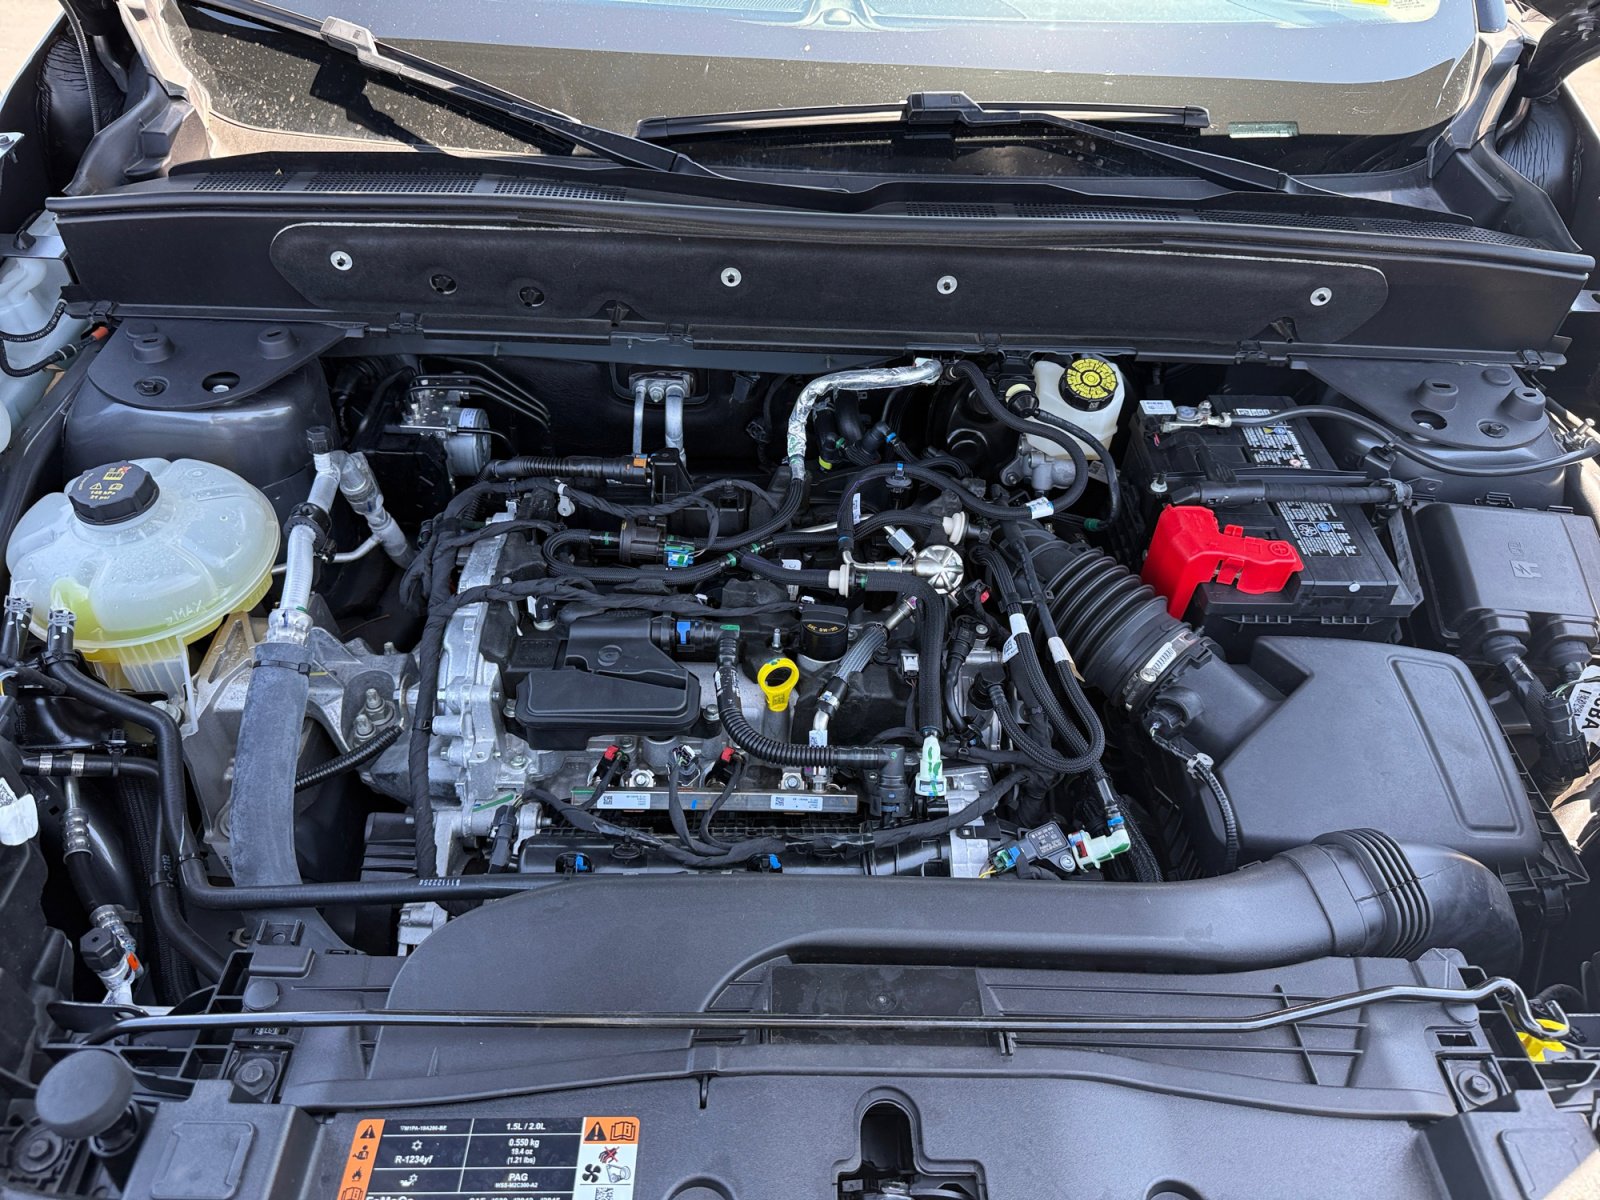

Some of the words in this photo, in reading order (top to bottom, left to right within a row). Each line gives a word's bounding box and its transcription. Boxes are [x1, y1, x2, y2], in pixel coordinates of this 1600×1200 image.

[172, 600, 206, 621] MAX
[506, 1122, 523, 1131] 1.5L
[528, 1122, 546, 1130] 2.0L
[508, 1138, 529, 1147] 0.550
[530, 1138, 540, 1148] kg
[394, 1155, 434, 1166] R-1234yf
[506, 1156, 522, 1165] (1.21
[523, 1156, 536, 1165] lbs)
[508, 1173, 528, 1181] PAG
